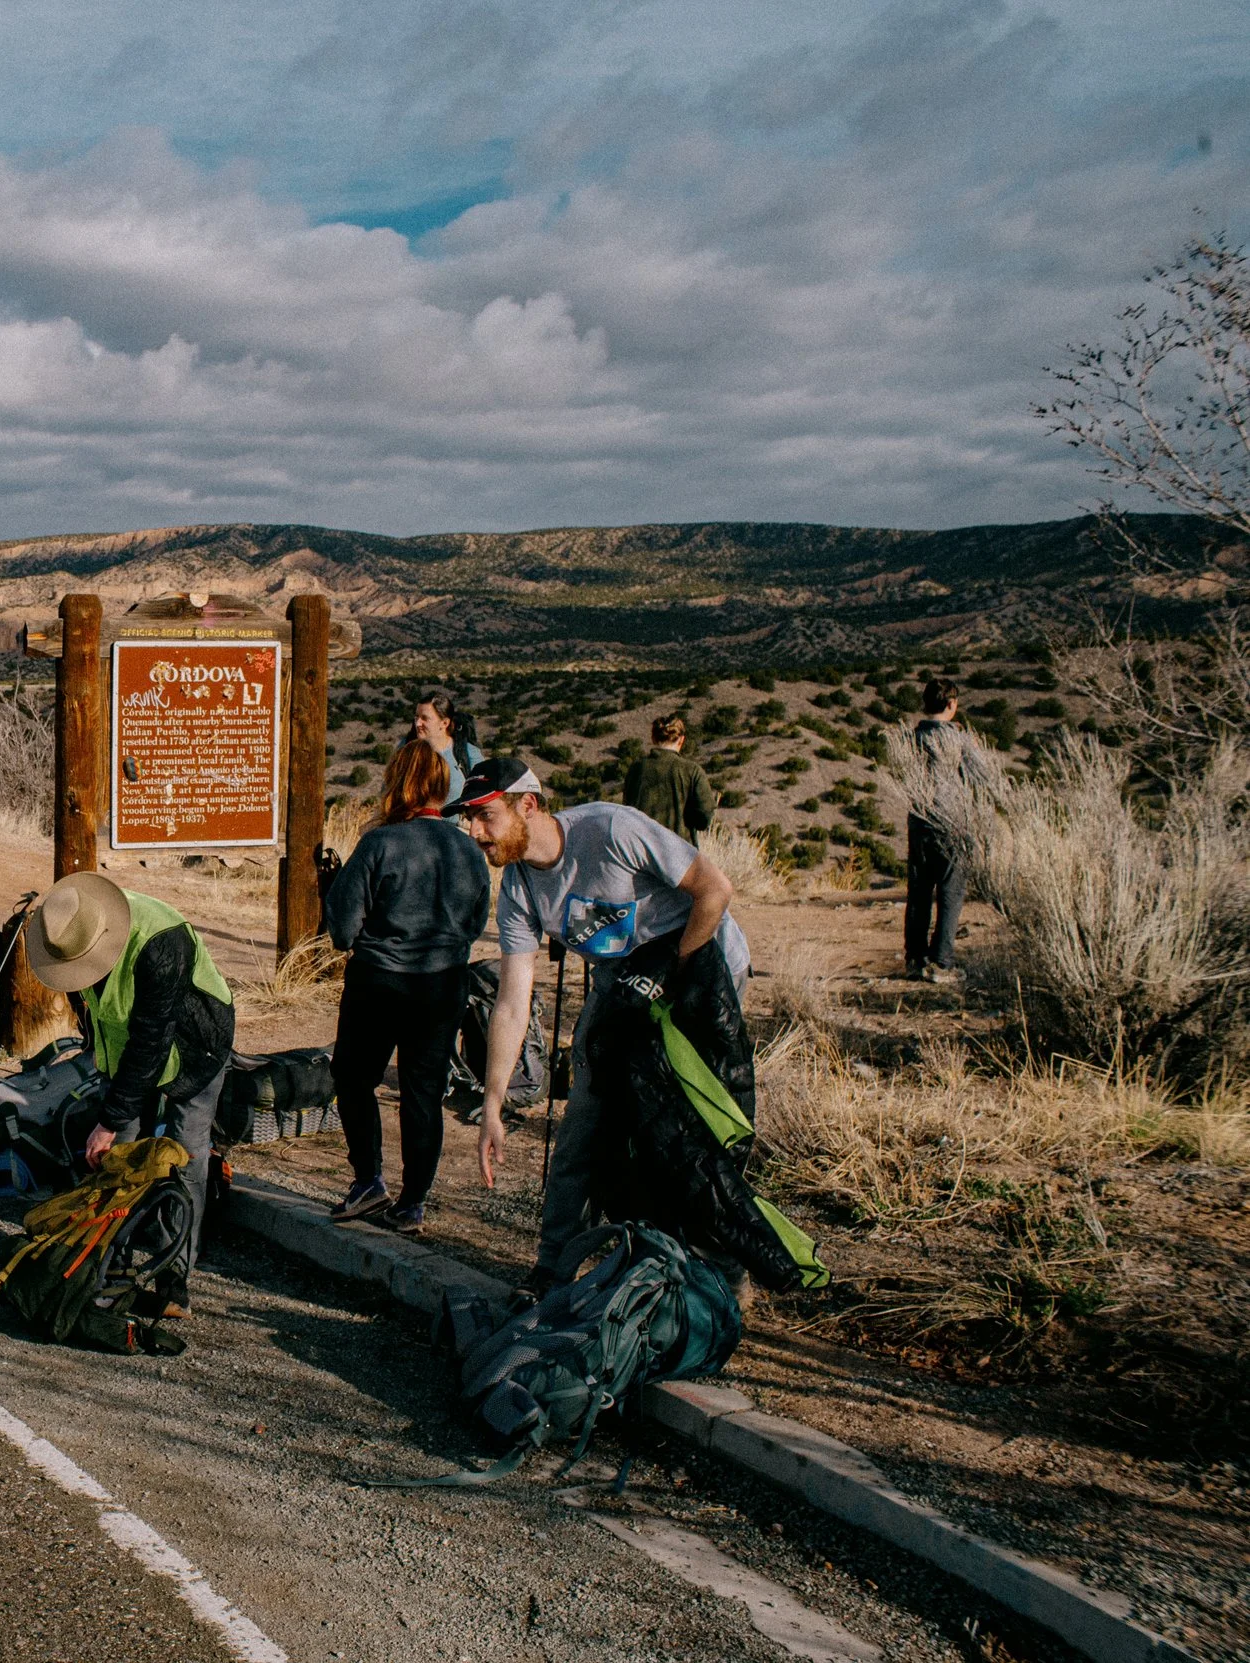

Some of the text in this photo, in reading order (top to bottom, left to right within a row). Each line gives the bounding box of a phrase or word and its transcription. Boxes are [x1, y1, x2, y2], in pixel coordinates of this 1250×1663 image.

[120, 629, 274, 639] OFFICIAL SCENIC HISTORIC MARKER
[165, 707, 207, 718] originally
[242, 706, 271, 716] Pueblo
[122, 717, 163, 728] Quemado
[163, 717, 185, 726] after
[192, 717, 220, 728] nearby
[222, 716, 271, 725] burned-out
[122, 727, 152, 737] Indian
[156, 727, 191, 737] Pueblo,
[213, 726, 271, 737] permanently
[122, 736, 158, 746] resettled
[159, 737, 168, 746] in
[169, 736, 190, 745] 1750
[191, 735, 211, 745] after
[240, 735, 271, 744] attacks.
[122, 745, 271, 756] It was renamed Córdova in 1900
[152, 756, 196, 767] prominent
[198, 755, 218, 765] local
[219, 755, 250, 766] family.
[253, 754, 271, 763] The
[181, 766, 197, 775] San
[199, 766, 231, 775] Antonio
[231, 765, 242, 774] de
[242, 765, 270, 774] Padua,
[122, 777, 129, 786] is
[141, 776, 189, 787] outstanding
[234, 773, 270, 784] Northern
[122, 782, 271, 796] New Mexio art and architecture.
[122, 795, 158, 805] Córdova
[192, 796, 200, 804] to
[209, 795, 239, 806] unique
[239, 794, 259, 804] style
[260, 793, 270, 802] of
[122, 803, 270, 815] woodcarving begun by Jose Dolores
[122, 815, 150, 826] Lopez
[567, 907, 629, 946] CREATIO
